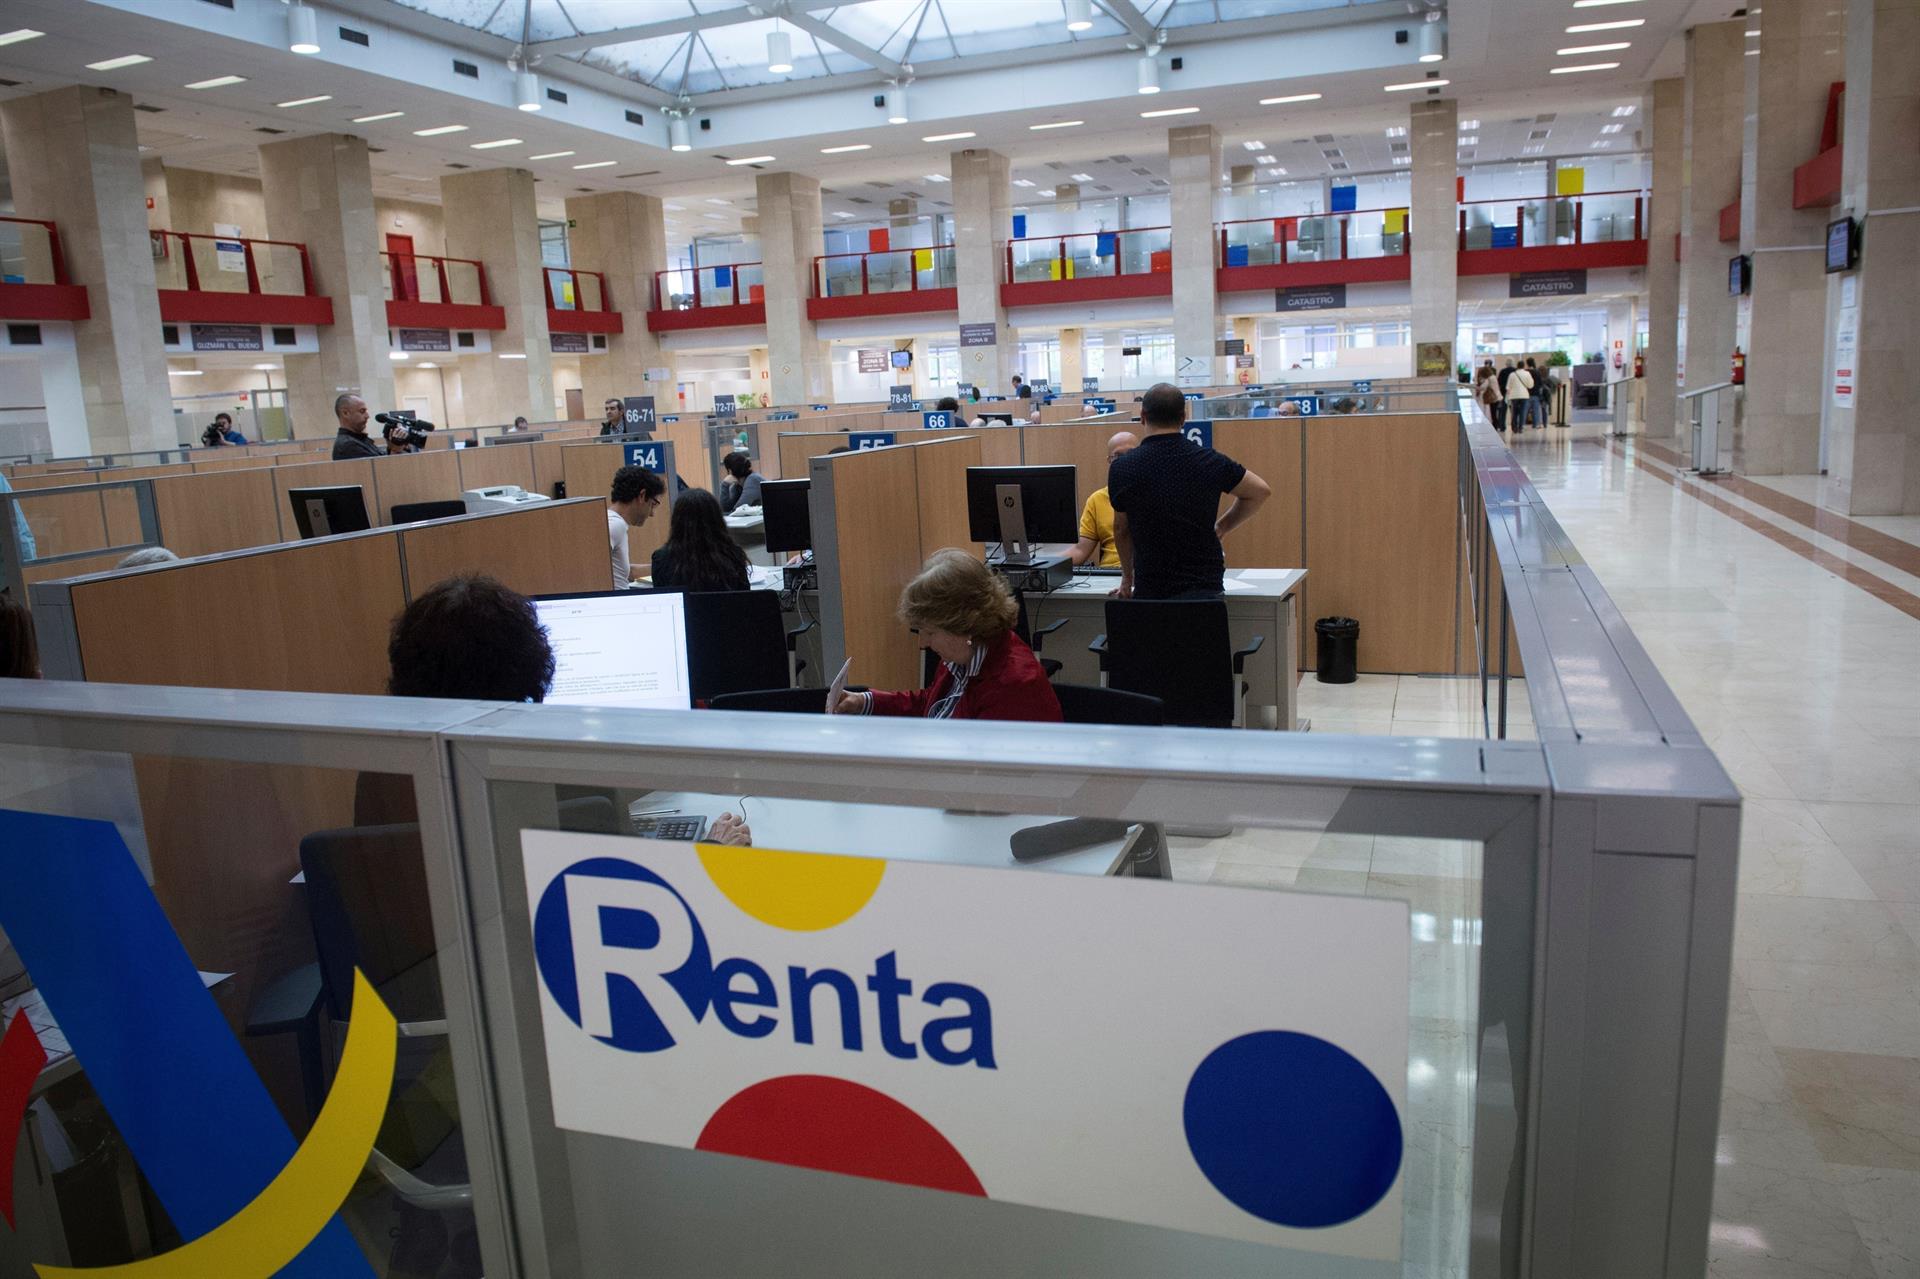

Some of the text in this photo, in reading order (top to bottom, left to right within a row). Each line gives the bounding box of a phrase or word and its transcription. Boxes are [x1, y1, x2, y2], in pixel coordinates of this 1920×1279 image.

[1522, 282, 1574, 293] CATASTRO
[1287, 297, 1335, 306] CATASTRO
[891, 392, 912, 403] 78-81
[715, 402, 735, 412] 72-77
[626, 408, 654, 423] 66-71
[929, 414, 946, 428] 66
[633, 448, 657, 468] 54
[562, 873, 998, 1070] Renta
